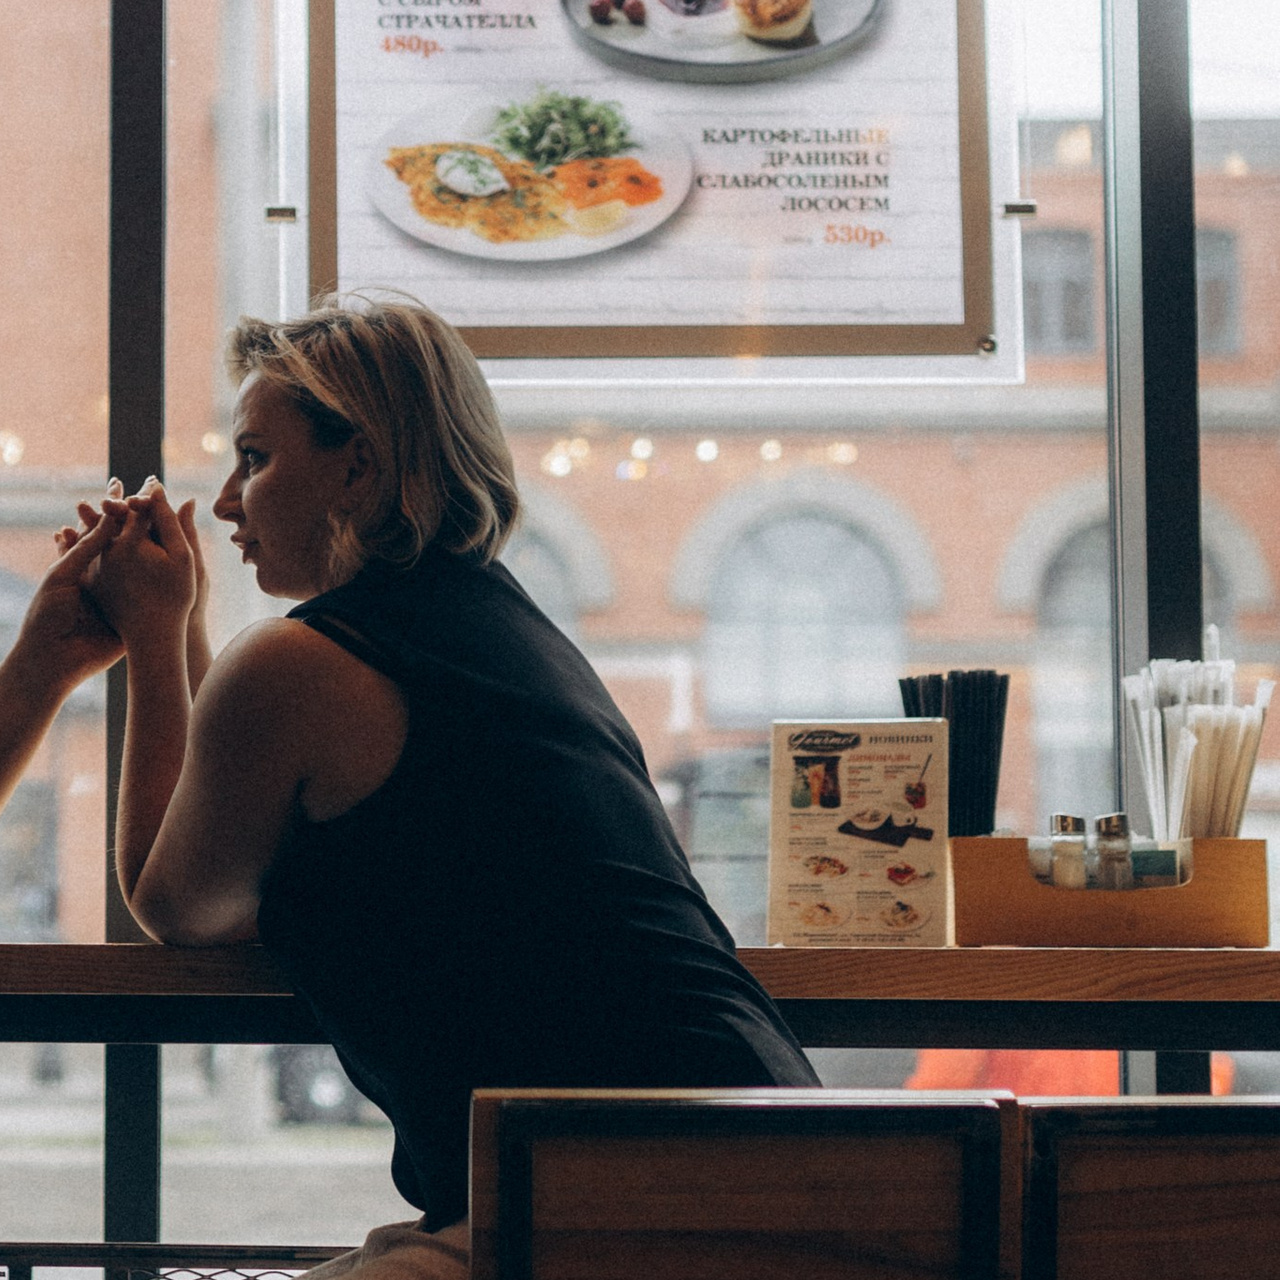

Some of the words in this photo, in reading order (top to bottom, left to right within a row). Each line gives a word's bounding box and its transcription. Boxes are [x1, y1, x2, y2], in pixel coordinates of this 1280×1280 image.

[378, 14, 537, 29] СТРАЧАТЕЛЛА
[701, 128, 889, 144] КАРТОФЕЛЬНЫЕ
[762, 151, 868, 168] ДРАНИКИ
[876, 151, 890, 166] С
[697, 174, 889, 189] СЛАБОСОЛЕНЫМ
[781, 197, 890, 211] ЛОСОСЕМ
